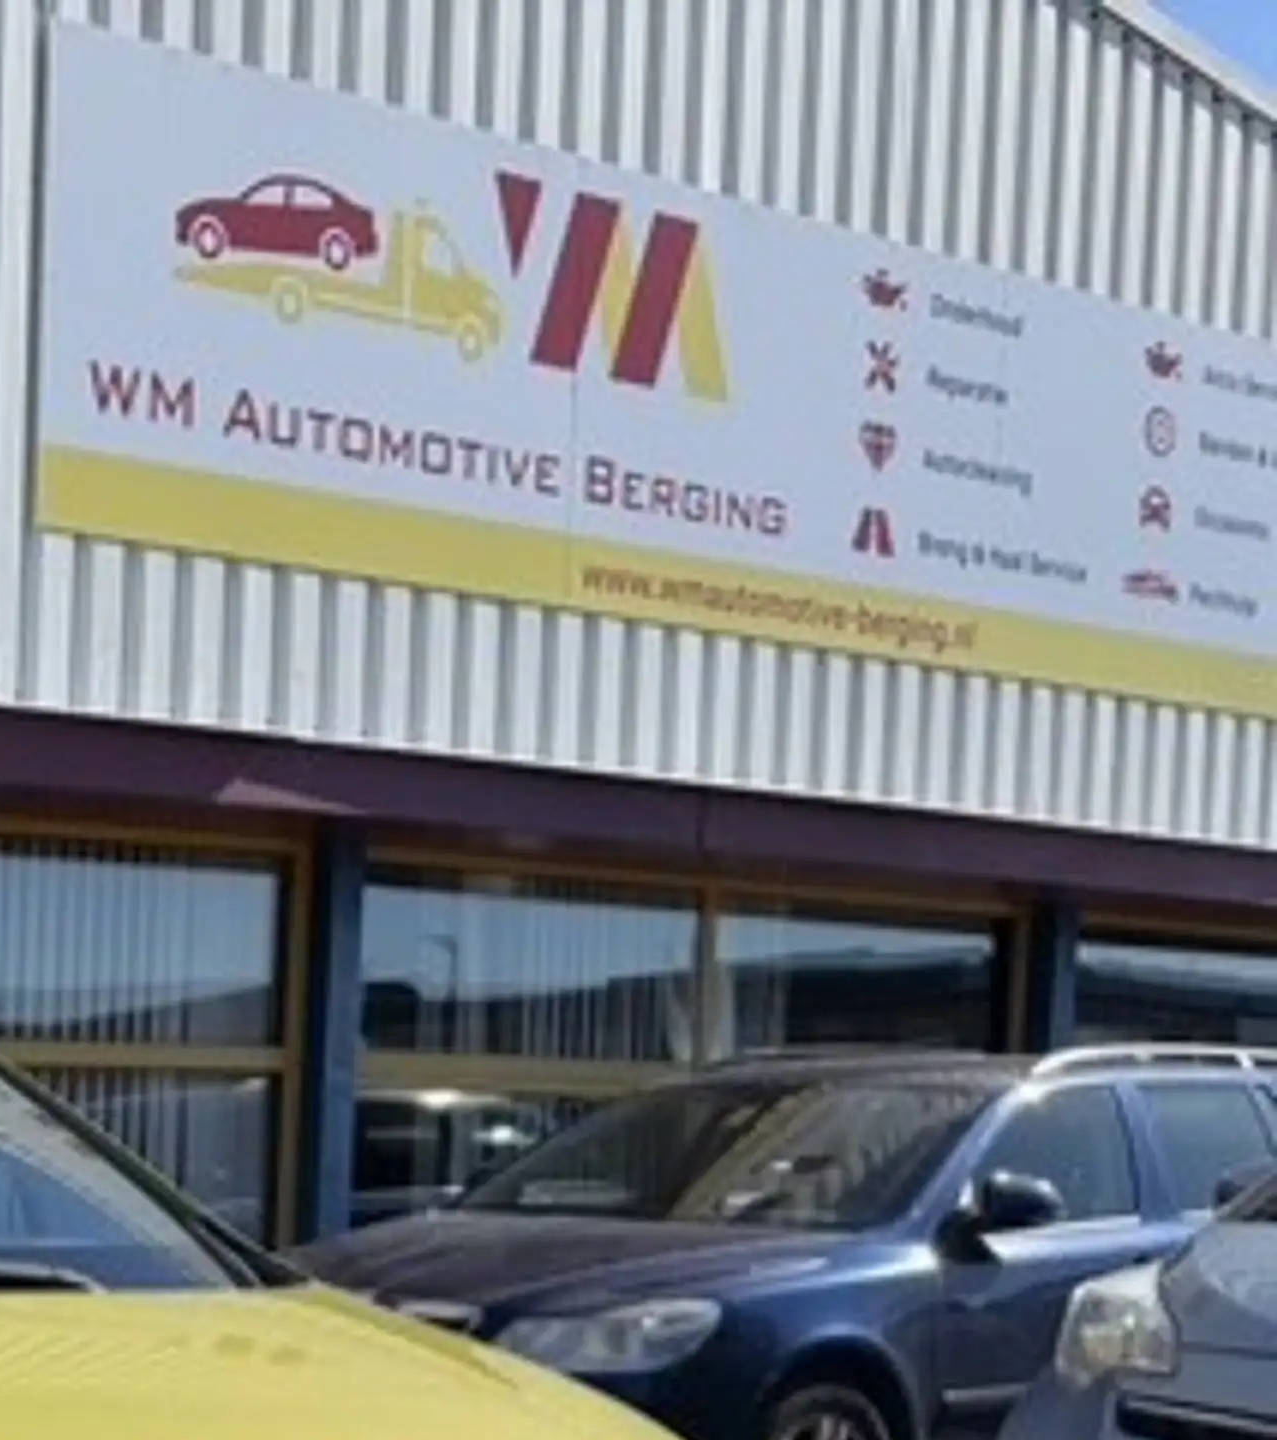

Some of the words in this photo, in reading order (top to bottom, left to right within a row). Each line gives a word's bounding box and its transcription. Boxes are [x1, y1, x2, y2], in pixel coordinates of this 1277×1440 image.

[88, 358, 196, 430] WM
[222, 388, 562, 500] AUTOMOTIVE
[581, 455, 789, 537] BERGING
[583, 565, 977, 653] www.wmautomotive-berging.nl
